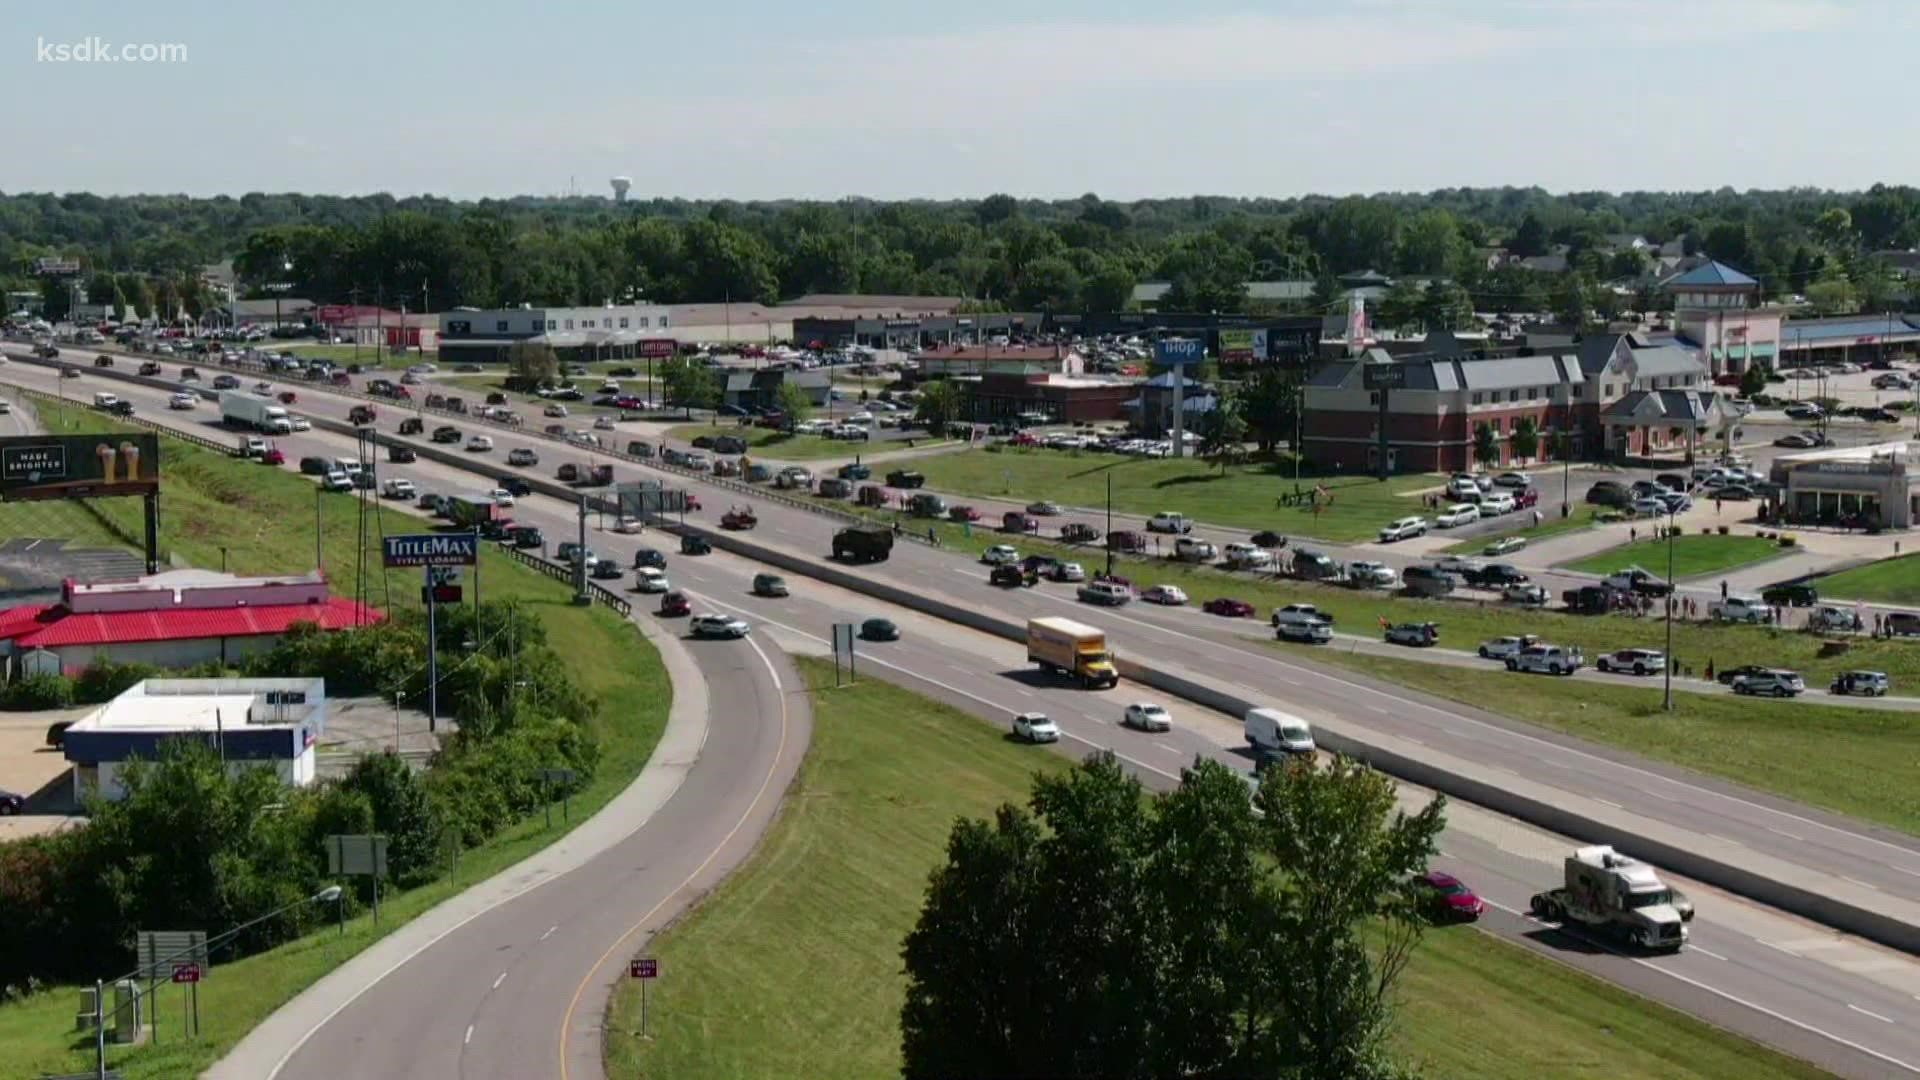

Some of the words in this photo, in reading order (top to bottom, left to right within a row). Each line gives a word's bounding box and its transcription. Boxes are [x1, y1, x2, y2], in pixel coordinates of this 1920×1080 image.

[20, 452, 48, 461] MADE
[9, 460, 60, 471] BRIGHTER
[396, 556, 425, 565] TITLE
[428, 556, 464, 564] LOANS
